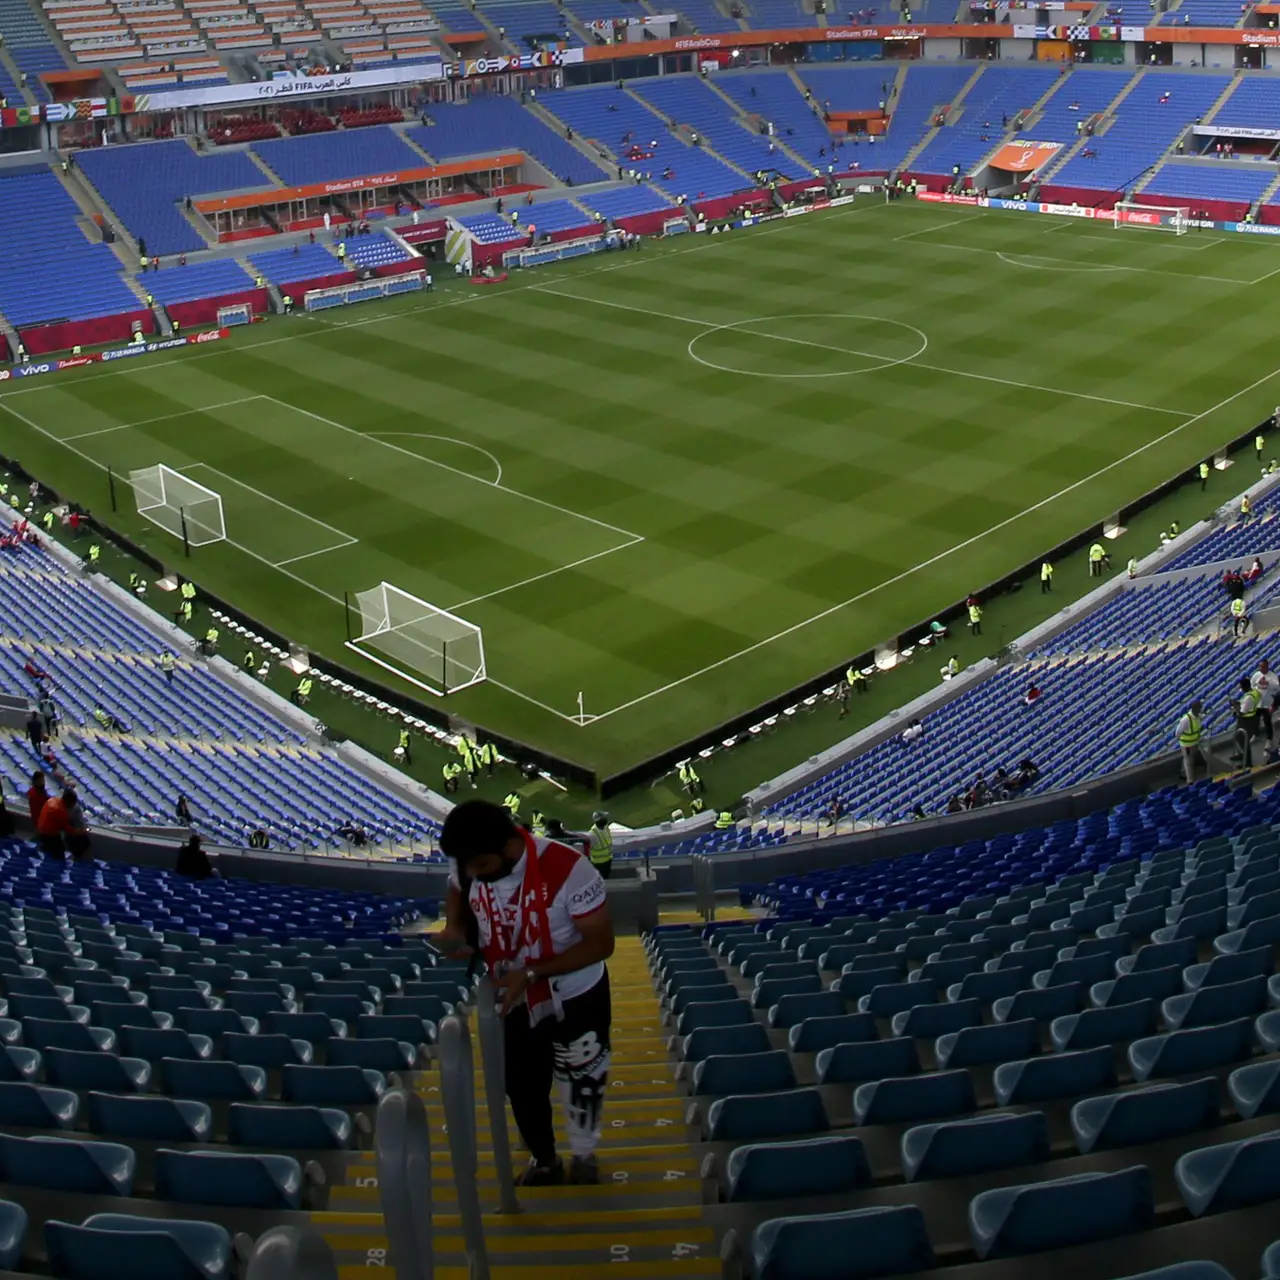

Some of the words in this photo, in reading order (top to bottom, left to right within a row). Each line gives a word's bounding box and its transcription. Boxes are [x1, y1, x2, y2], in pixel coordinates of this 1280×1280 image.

[826, 30, 861, 39] Stadium
[862, 29, 878, 38] 974
[1242, 34, 1277, 43] Stadium
[295, 82, 313, 91] FIFA
[325, 182, 352, 192] Stadium
[159, 338, 187, 348] HYUNDAI
[365, 1247, 387, 1267] 28
